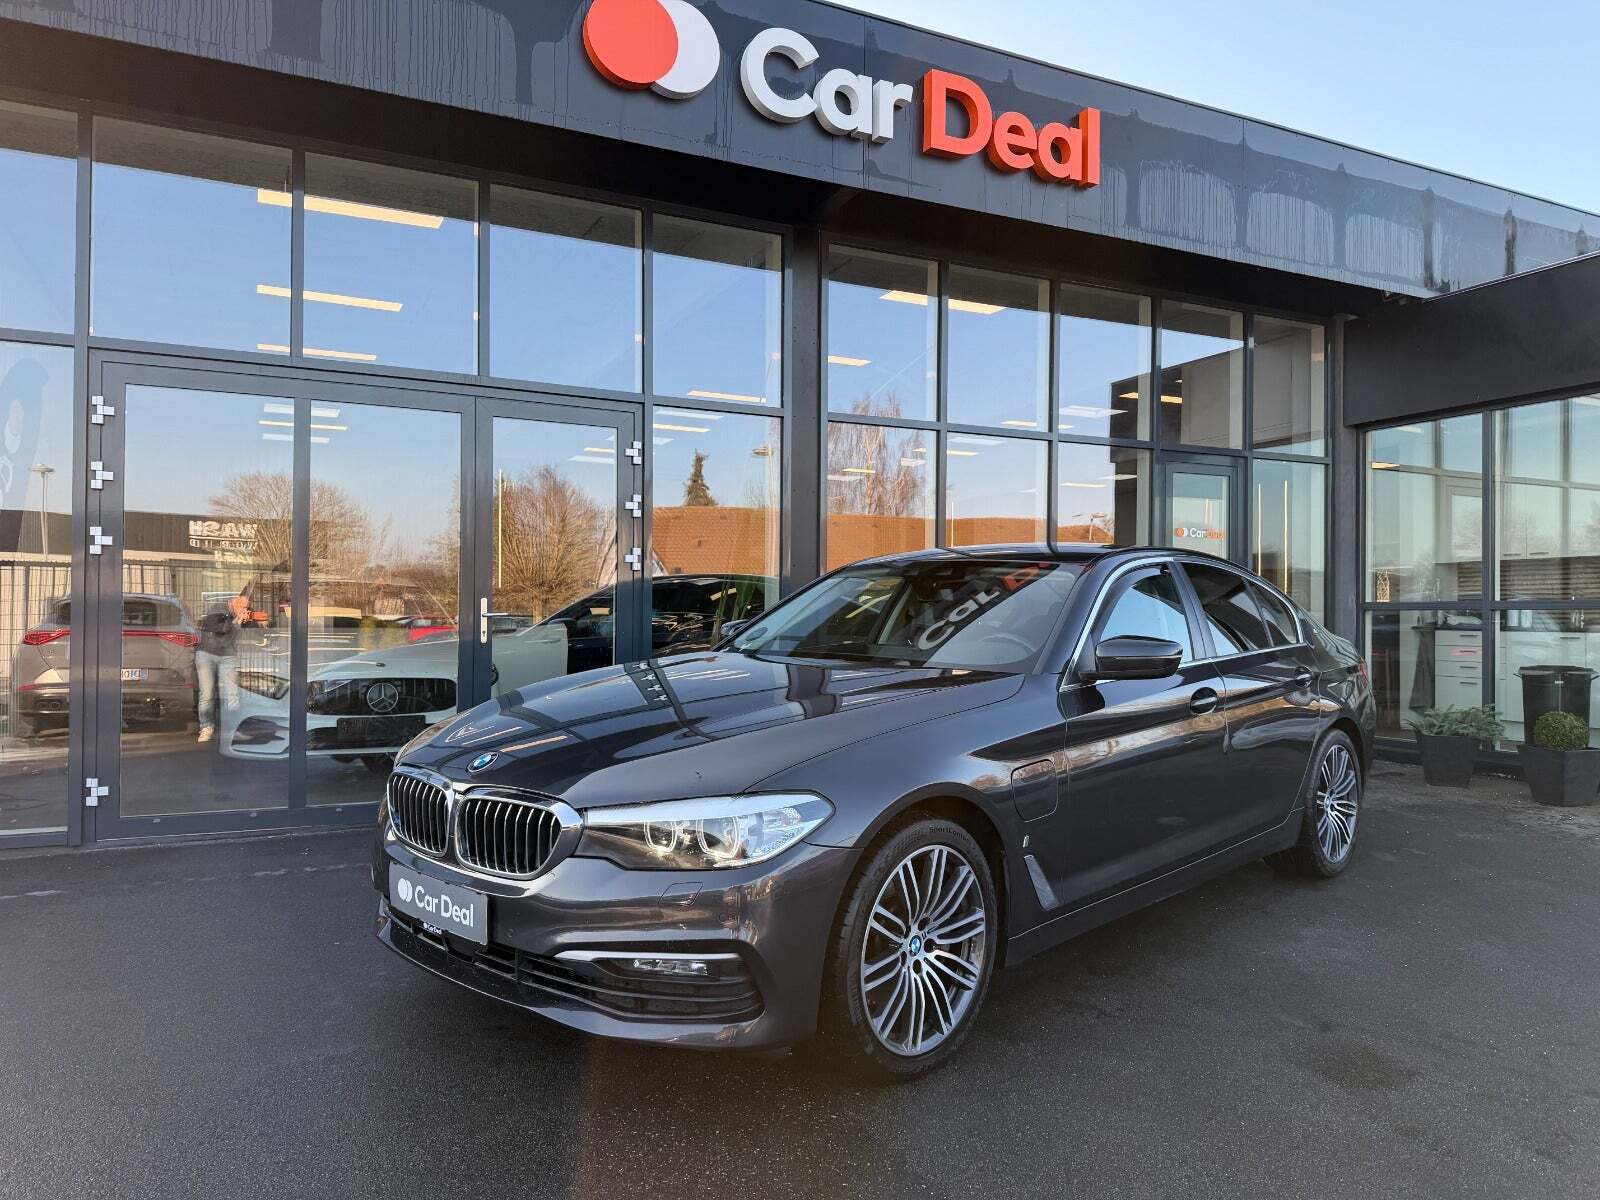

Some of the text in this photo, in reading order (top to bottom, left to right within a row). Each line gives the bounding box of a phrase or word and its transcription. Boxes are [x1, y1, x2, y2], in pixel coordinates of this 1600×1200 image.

[740, 27, 1100, 188] Car Deal
[415, 885, 474, 928] Car Deal
